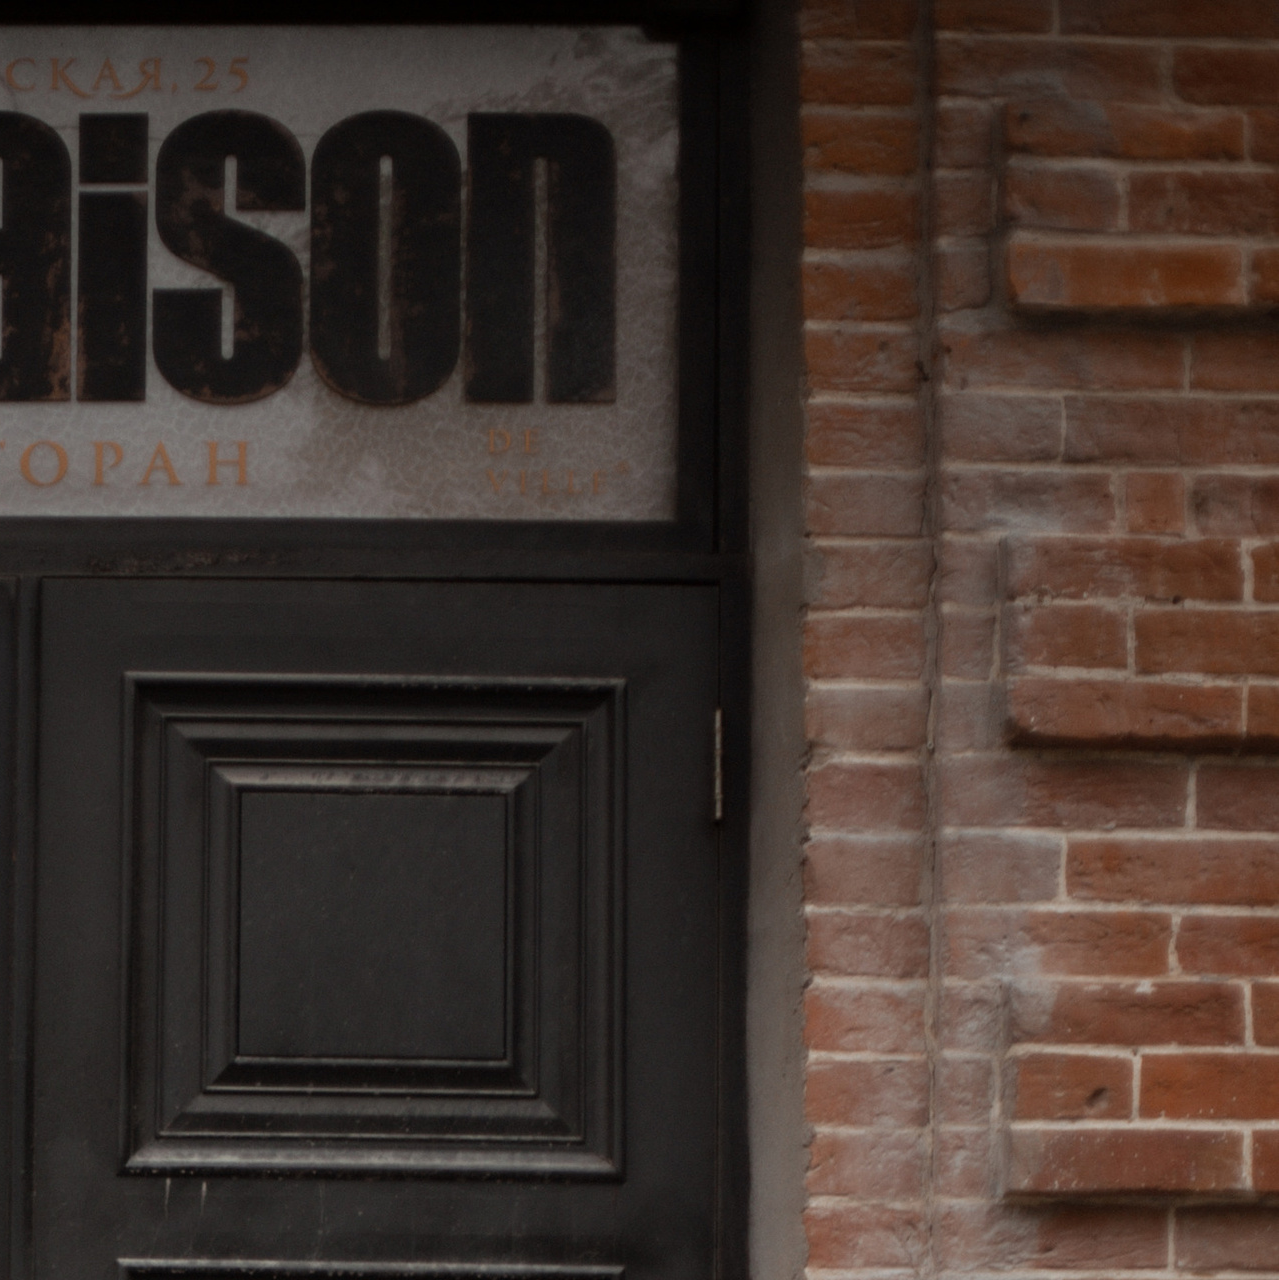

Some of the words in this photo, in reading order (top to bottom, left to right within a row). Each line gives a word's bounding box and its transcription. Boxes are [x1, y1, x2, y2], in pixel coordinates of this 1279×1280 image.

[193, 56, 249, 94] 25
[487, 427, 542, 456] DE
[485, 467, 610, 496] VILLE
